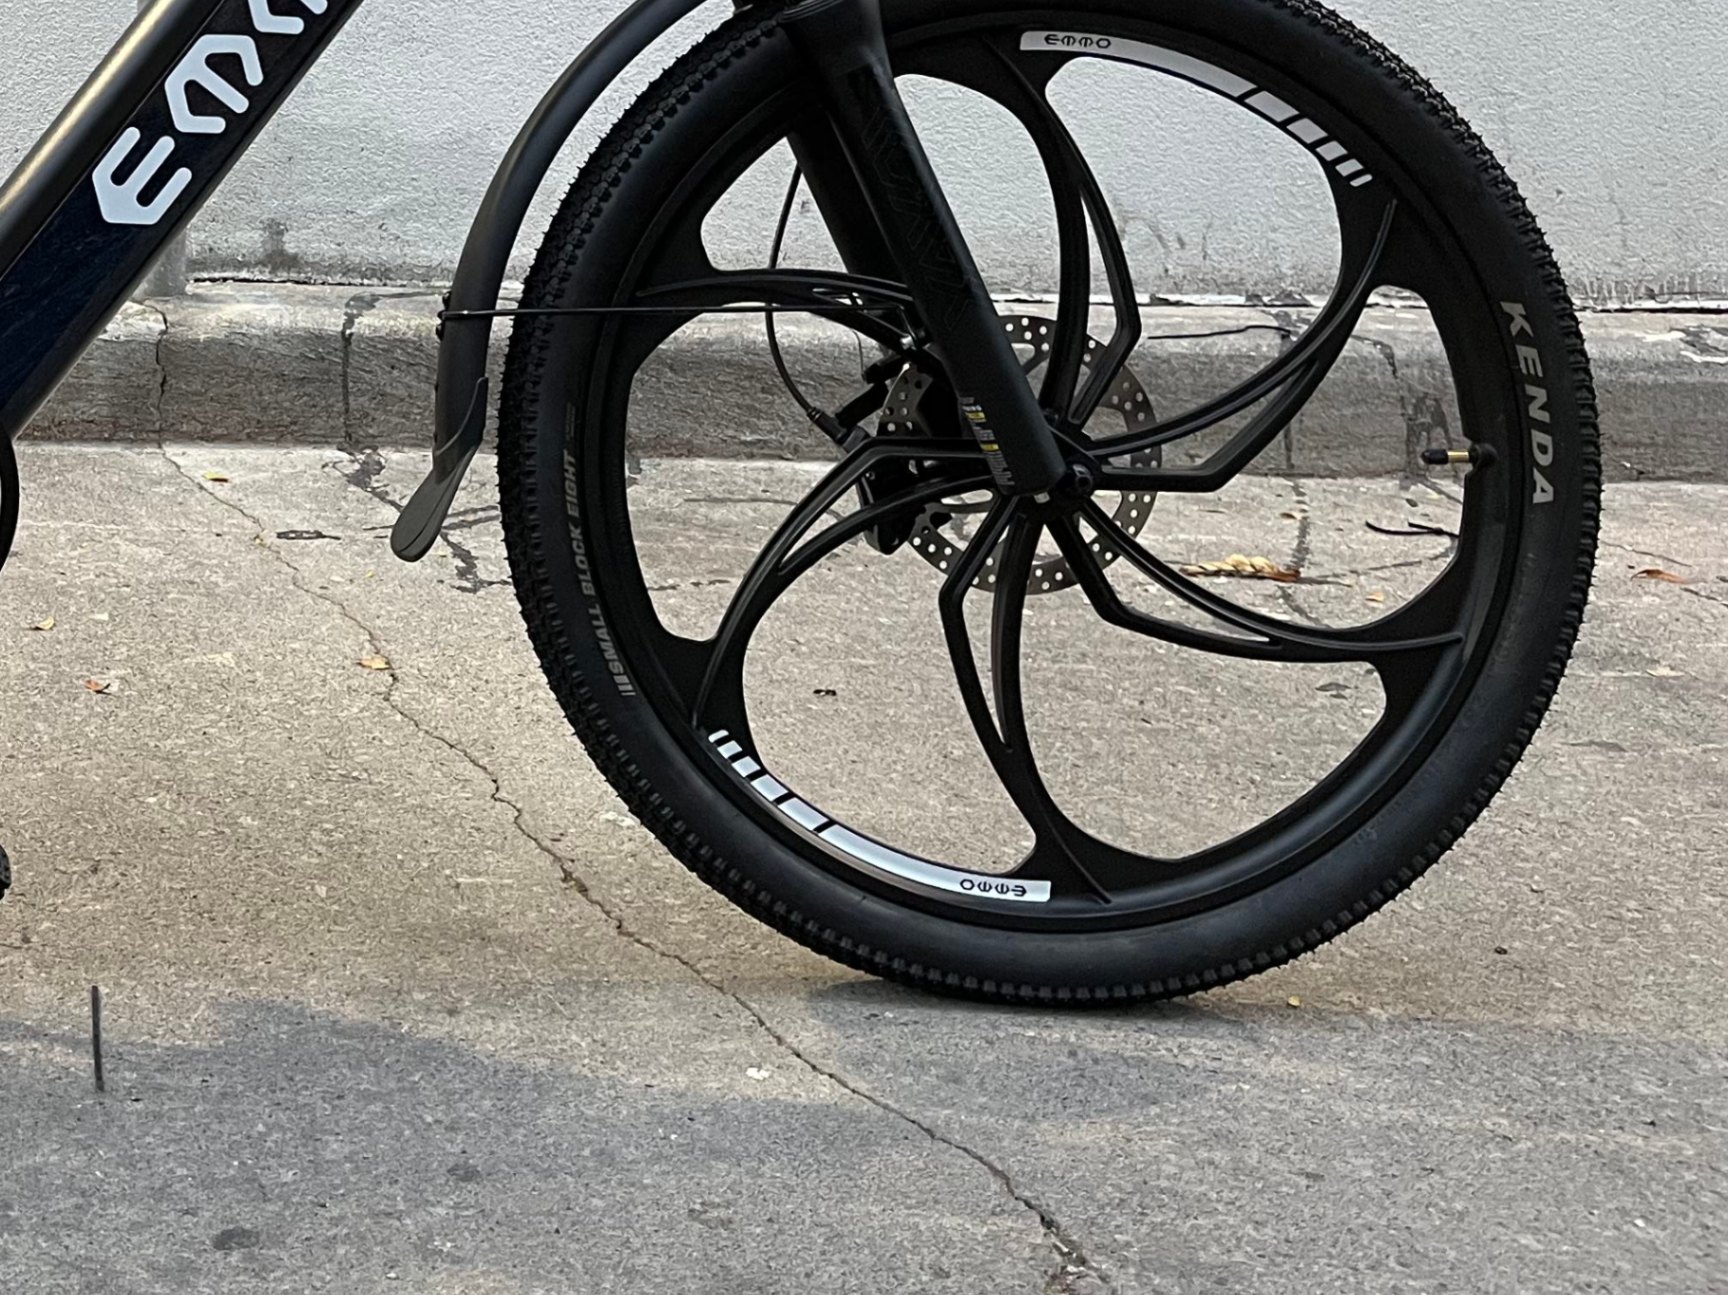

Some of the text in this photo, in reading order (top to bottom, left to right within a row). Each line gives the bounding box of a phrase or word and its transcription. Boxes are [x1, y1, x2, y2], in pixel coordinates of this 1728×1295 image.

[1044, 33, 1111, 49] EMMO
[1500, 301, 1554, 504] KENDA
[563, 450, 625, 675] SMALL BLOCK EIGHT
[960, 879, 1027, 897] EMMO
